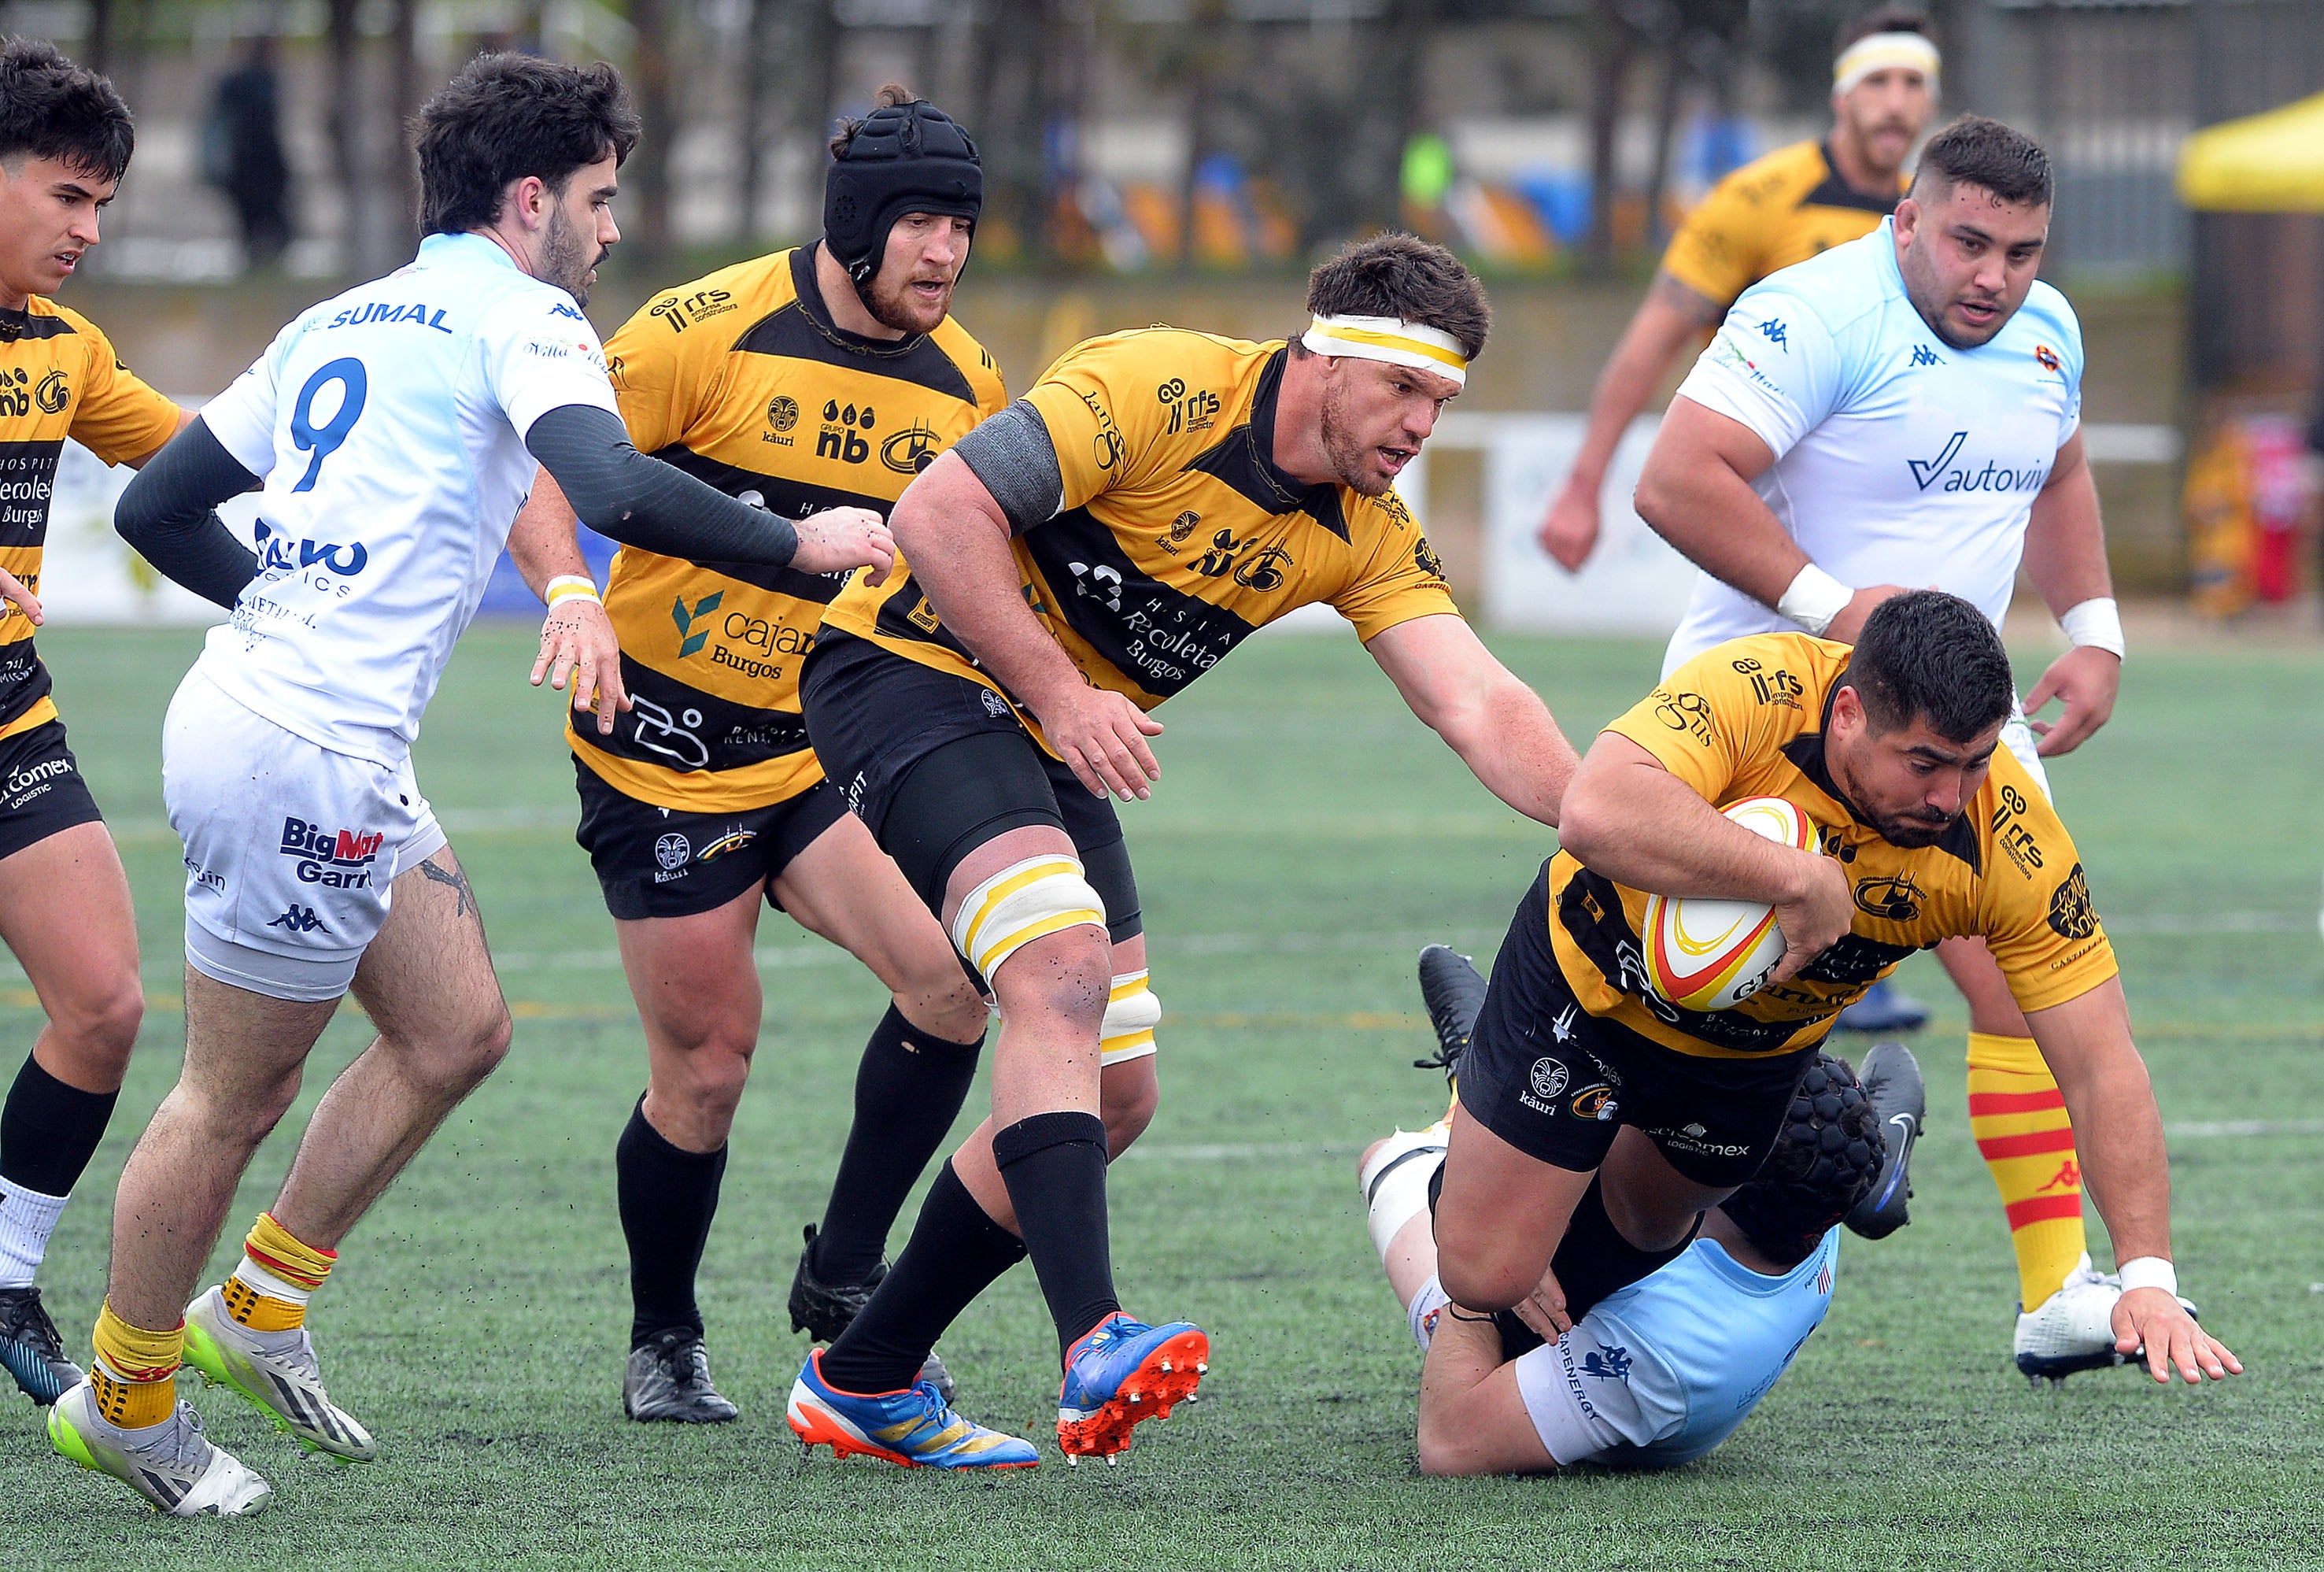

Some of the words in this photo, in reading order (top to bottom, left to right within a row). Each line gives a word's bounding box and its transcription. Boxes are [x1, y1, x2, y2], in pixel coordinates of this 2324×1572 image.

[327, 302, 453, 335] SUMAL
[1188, 390, 1221, 419] rfs
[291, 357, 367, 493] 9
[762, 431, 795, 447] kāuri
[820, 423, 845, 435] GRUPO
[815, 429, 870, 464] nb
[711, 644, 783, 680] Burgos
[1126, 639, 1187, 682] Burgos
[10, 782, 53, 810] LOGISTIC
[281, 816, 384, 862] BigMat
[2004, 834, 2026, 863] empresa
[1999, 838, 2033, 881] constructora
[1518, 1089, 1557, 1116] kāuri
[1667, 1140, 1710, 1156] LOGISTIC
[1560, 1333, 1601, 1420] CAPENERGY
